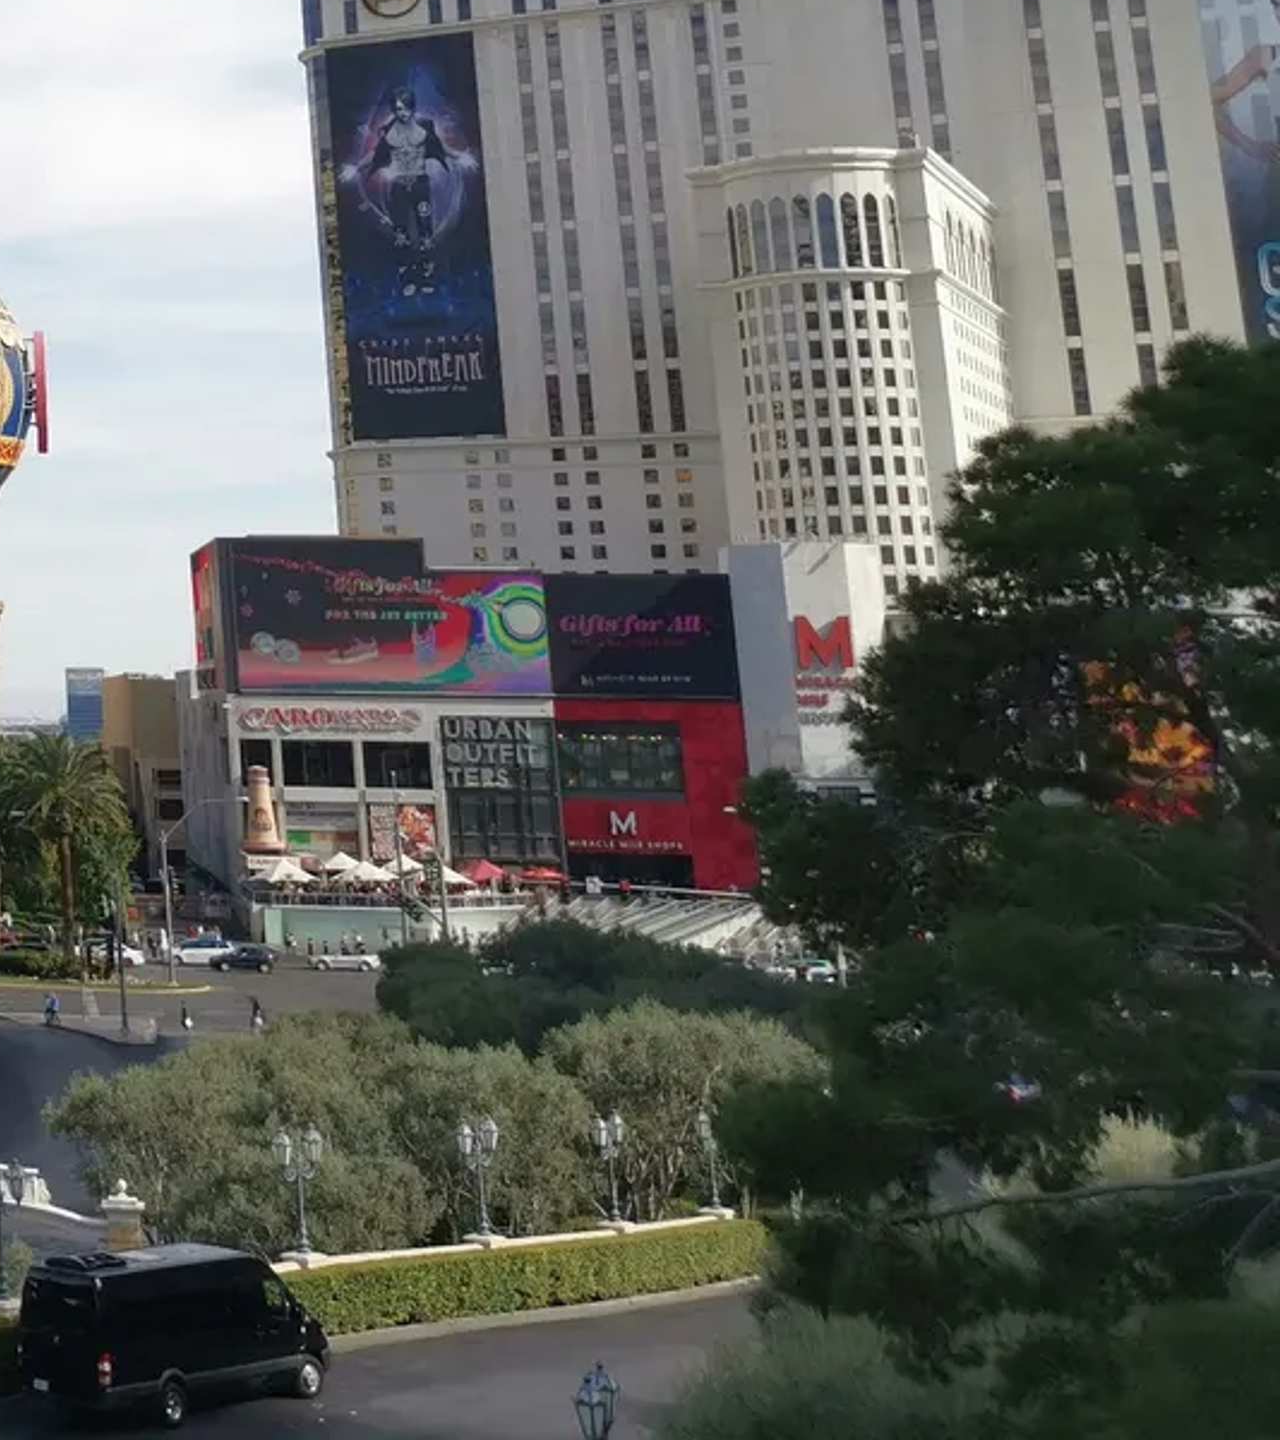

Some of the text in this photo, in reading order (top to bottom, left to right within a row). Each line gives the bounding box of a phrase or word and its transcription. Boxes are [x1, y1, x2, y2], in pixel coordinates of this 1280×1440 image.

[559, 614, 618, 637] Gifts
[621, 614, 663, 637] for
[793, 615, 853, 668] M
[443, 718, 531, 739] URBAN
[446, 743, 538, 764] OUTFIT
[446, 767, 511, 789] TERS
[609, 810, 638, 836] M
[567, 839, 615, 849] MIRACLE
